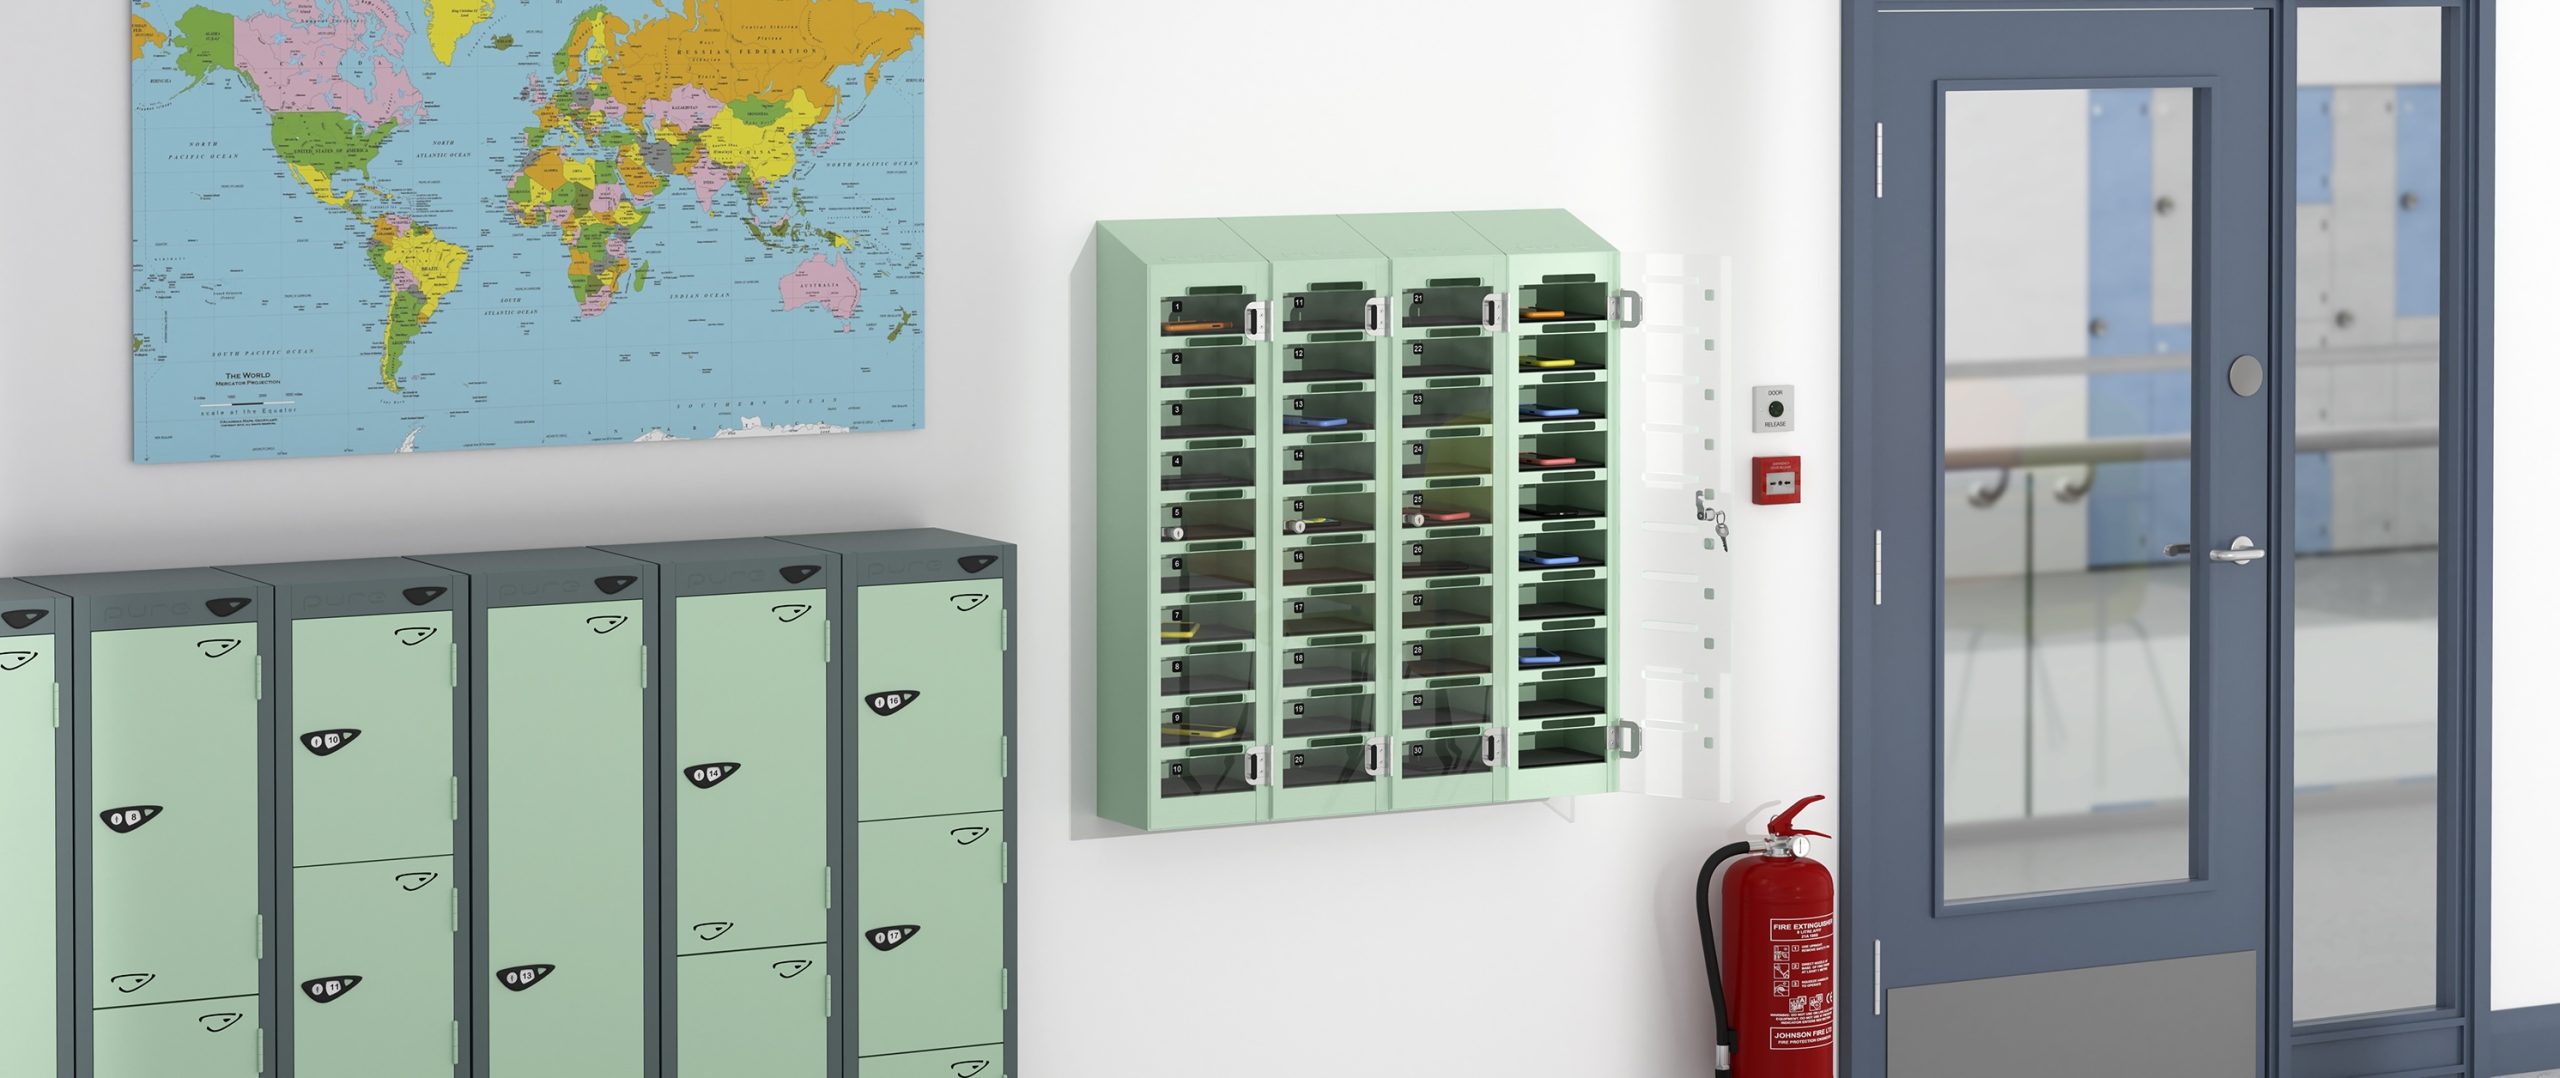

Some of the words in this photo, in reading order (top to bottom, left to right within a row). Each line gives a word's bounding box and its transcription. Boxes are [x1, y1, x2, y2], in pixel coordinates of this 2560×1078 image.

[242, 371, 271, 379] WORLD
[1174, 405, 1180, 413] 3
[1174, 559, 1180, 567] 6
[866, 558, 943, 578] pure
[687, 567, 767, 590] pure
[498, 579, 581, 601] pure
[303, 591, 386, 614] pure
[104, 601, 191, 623] pure
[329, 736, 338, 744] 10
[131, 813, 137, 821] 8
[1773, 923, 1792, 931] FIRE
[522, 972, 532, 980] 13
[330, 983, 339, 991] 11
[1774, 1031, 1812, 1039] JOHNSON
[1812, 1029, 1826, 1037] FIRE
